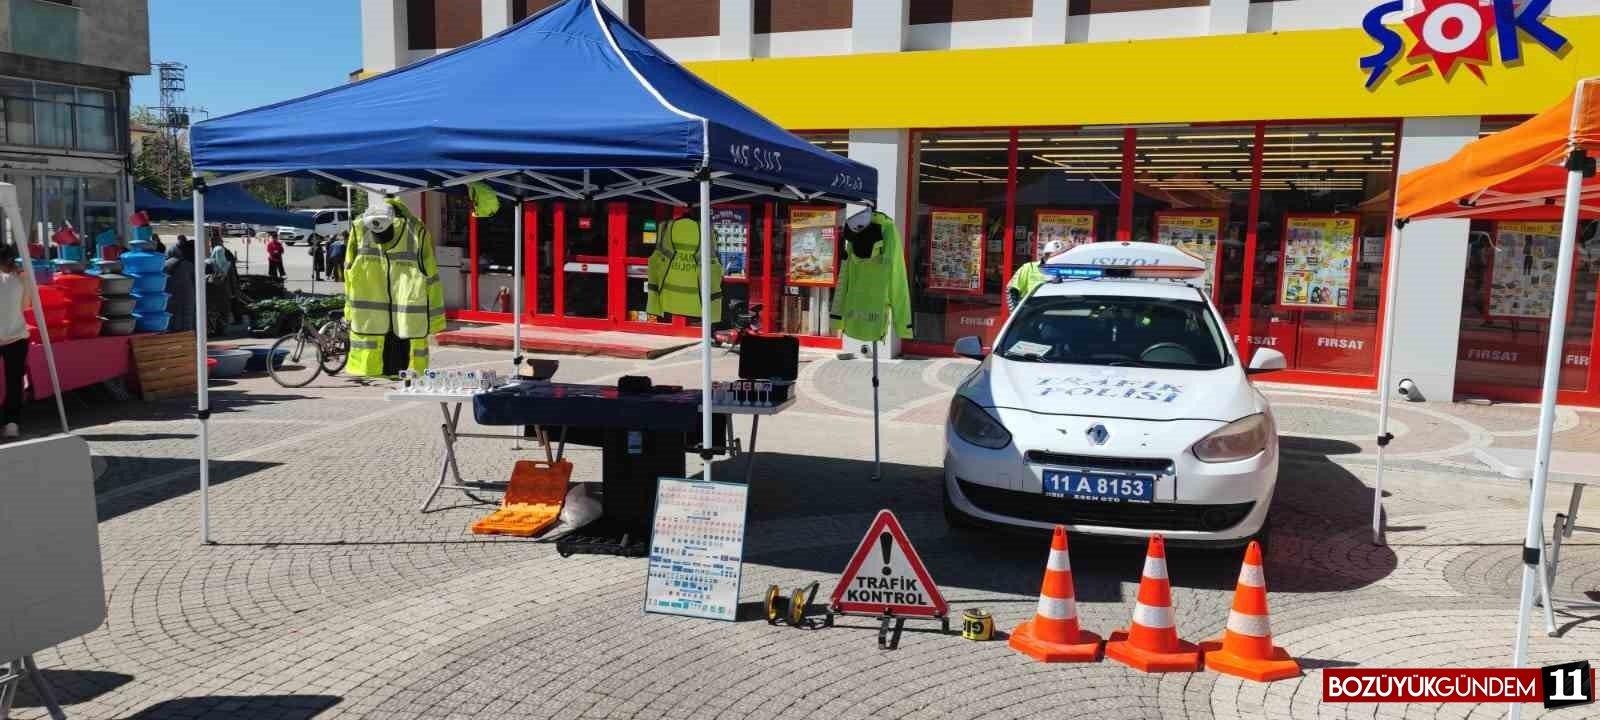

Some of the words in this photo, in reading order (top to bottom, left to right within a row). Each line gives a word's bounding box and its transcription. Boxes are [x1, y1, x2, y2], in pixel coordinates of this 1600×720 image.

[1360, 0, 1568, 88] ŞOK
[1234, 334, 1279, 346] FRSAT
[1317, 336, 1365, 350] FIRSAT
[1467, 348, 1520, 361] FIRSAT
[1565, 354, 1590, 366] FIR
[1051, 474, 1070, 491] 11
[1077, 477, 1092, 493] A
[1097, 478, 1144, 496] 8153
[856, 576, 918, 591] TRAFİK
[847, 590, 927, 605] KONTROL
